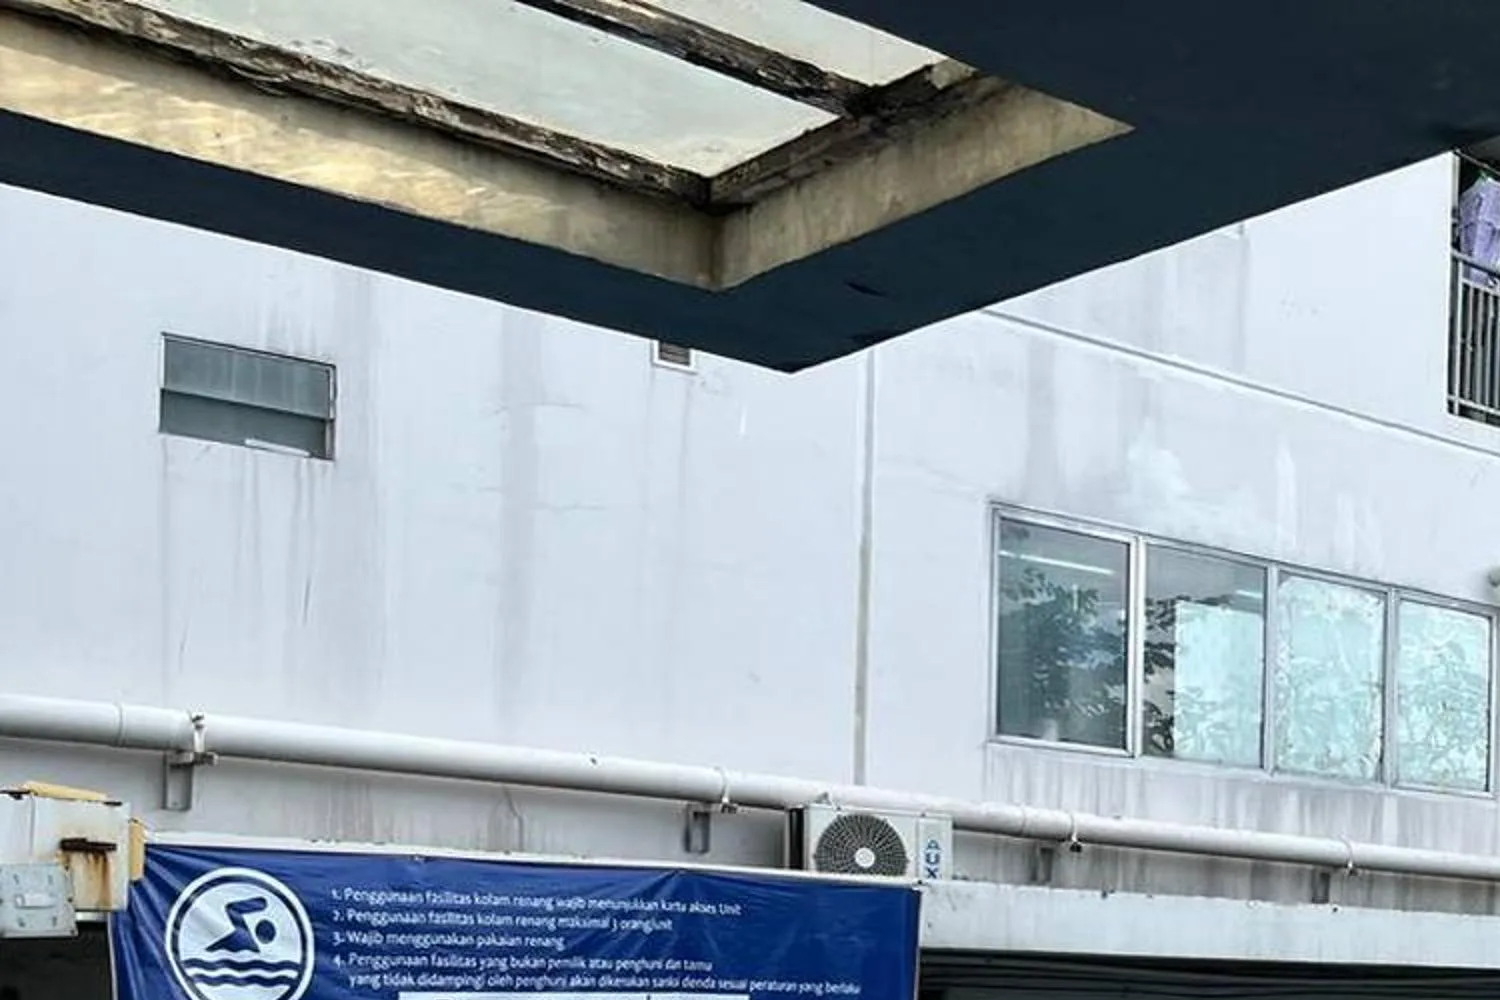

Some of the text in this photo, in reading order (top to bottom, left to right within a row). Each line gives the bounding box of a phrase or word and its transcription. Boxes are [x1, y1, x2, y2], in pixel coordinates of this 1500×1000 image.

[924, 839, 941, 879] AUX
[344, 887, 425, 906] Penggunaan
[425, 890, 472, 904] fasilitas
[474, 892, 510, 905] kolam
[512, 895, 554, 911] renang
[556, 897, 586, 911] wajib
[347, 908, 426, 927] Penggunaan
[428, 911, 474, 925] fasilitas
[476, 913, 513, 926] kolam
[515, 917, 556, 932] renang
[558, 916, 611, 930] maksimal
[346, 930, 385, 947] Wajib
[476, 933, 523, 948] pakaian
[524, 936, 566, 952] renang
[349, 952, 428, 970] Penggunaan
[431, 953, 477, 968] fasilitas
[479, 959, 509, 972] yang
[509, 956, 547, 969] bukan
[349, 973, 382, 990] yang
[383, 972, 416, 986] tidak
[487, 974, 514, 988] oleh
[568, 974, 597, 988] akan
